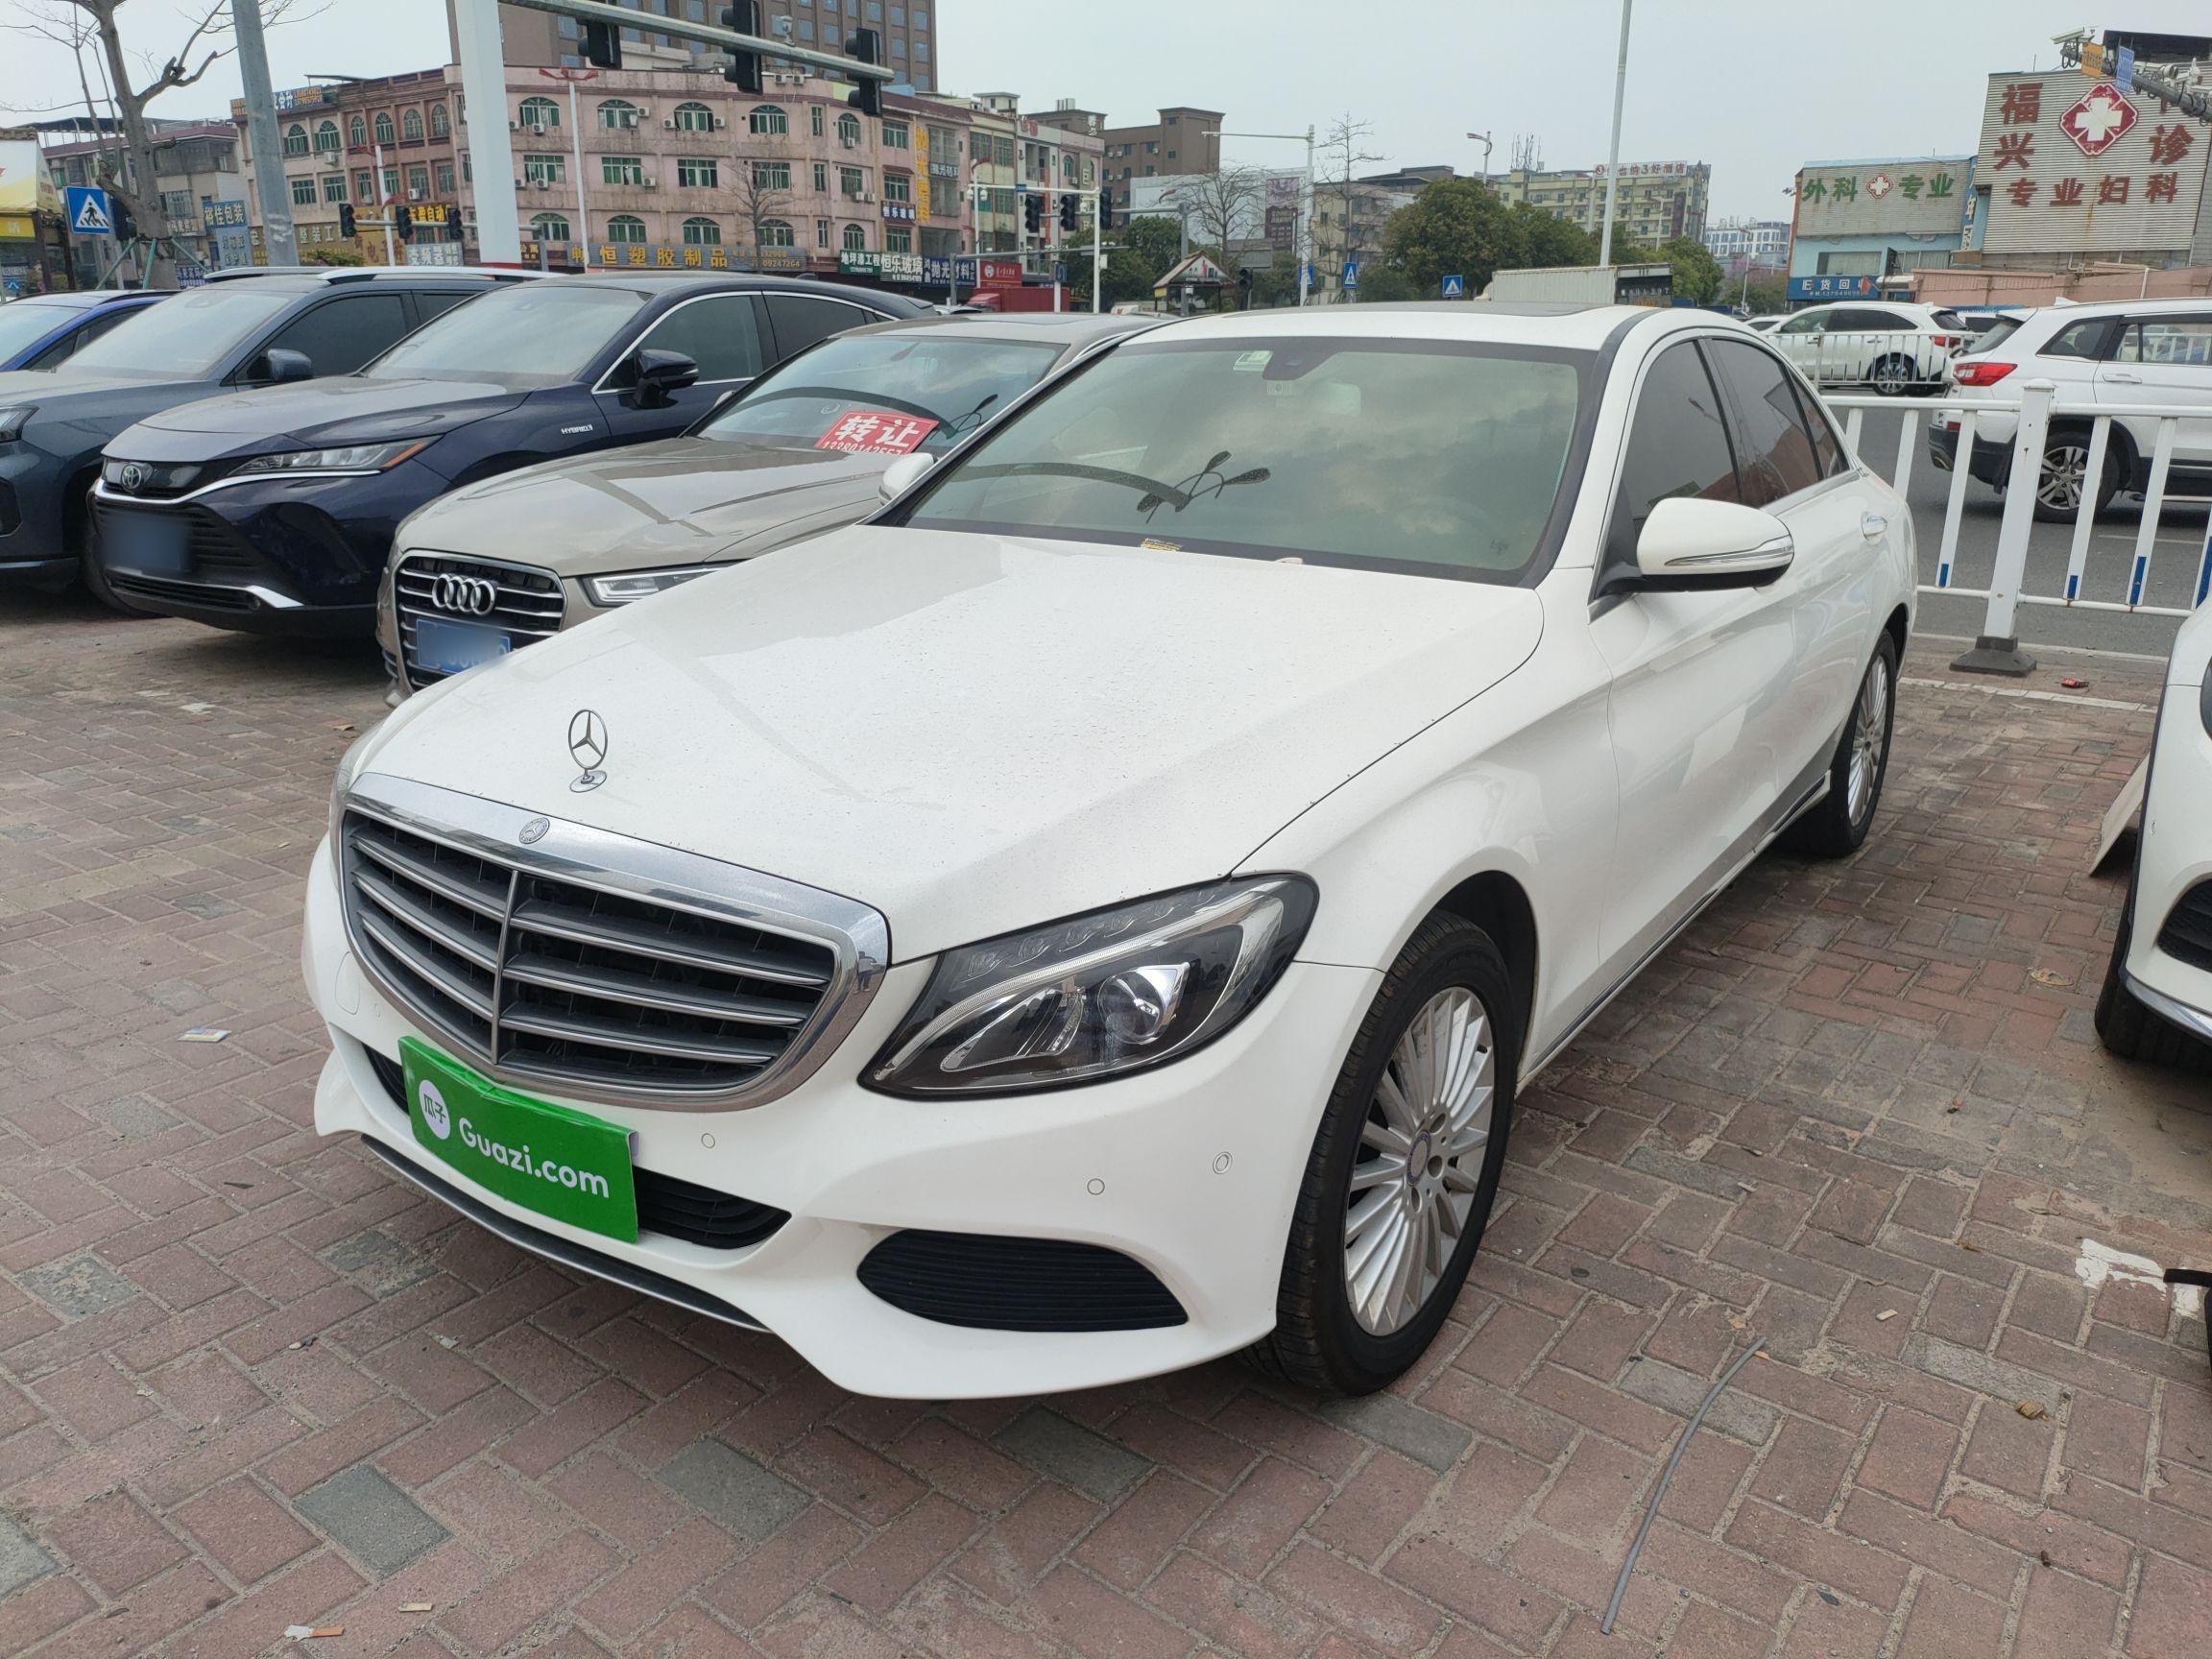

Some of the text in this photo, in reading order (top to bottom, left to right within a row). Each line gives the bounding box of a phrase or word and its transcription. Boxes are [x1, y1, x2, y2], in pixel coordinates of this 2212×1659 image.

[1991, 82, 2044, 171] 福兴
[1802, 173, 1956, 204] 外科 专业
[2006, 172, 2178, 207] 专业妇科
[204, 203, 245, 227] 裕佳包装
[299, 224, 348, 245] 整装工
[881, 253, 923, 276] 恒乐玻璃
[834, 415, 920, 447] 转让
[423, 1094, 446, 1124] 瓜子
[458, 1117, 610, 1199] Guazi.com
